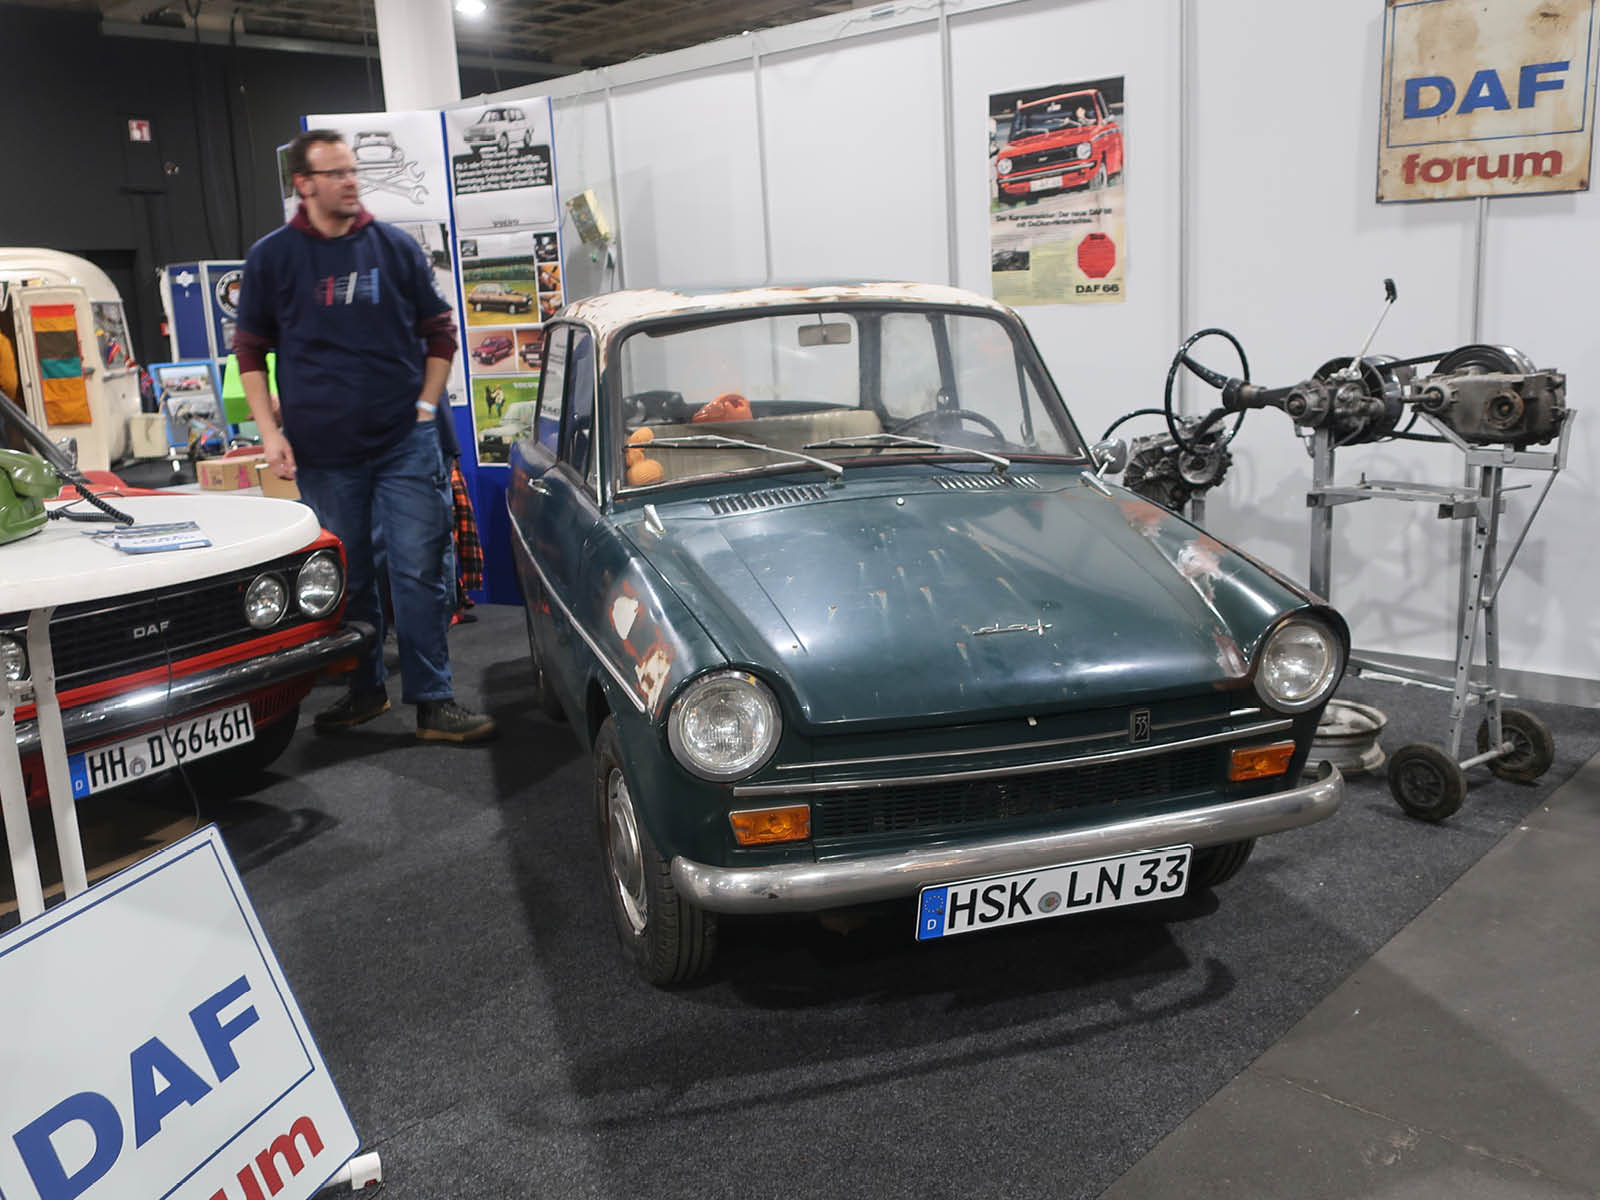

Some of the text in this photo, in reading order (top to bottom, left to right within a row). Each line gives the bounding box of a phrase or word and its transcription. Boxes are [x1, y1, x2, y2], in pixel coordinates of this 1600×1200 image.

[1403, 61, 1570, 120] DAF
[1402, 150, 1563, 184] forum
[1075, 284, 1120, 294] DAF 66
[133, 620, 169, 640] DAF
[74, 779, 84, 791] D
[89, 747, 128, 787] HH
[927, 854, 1187, 930] D HSK LN 33
[12, 974, 261, 1200] DAF
